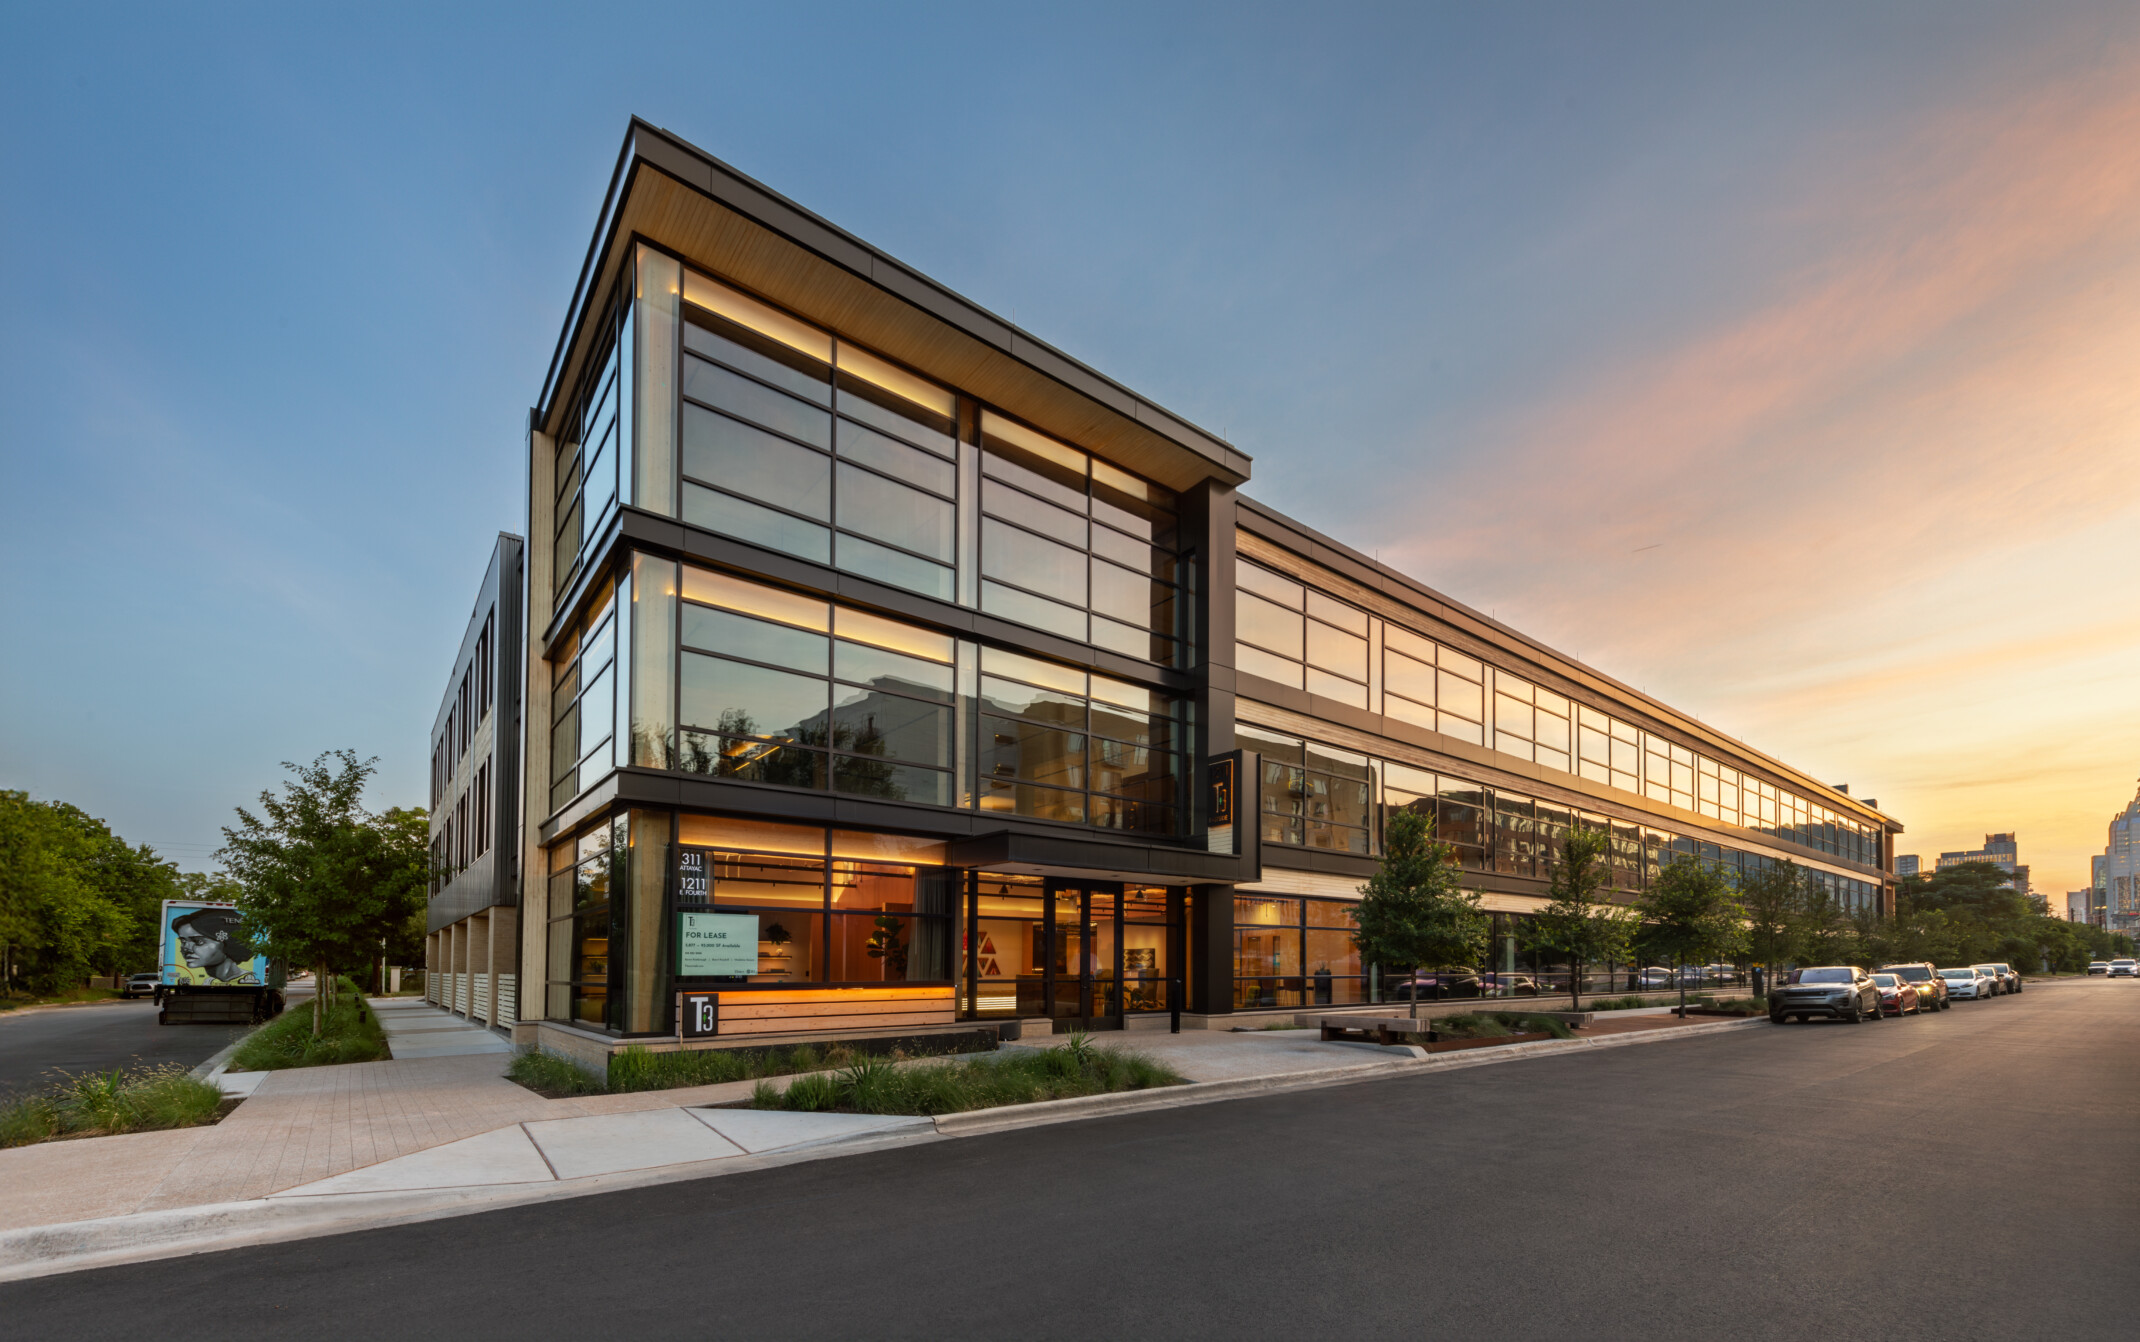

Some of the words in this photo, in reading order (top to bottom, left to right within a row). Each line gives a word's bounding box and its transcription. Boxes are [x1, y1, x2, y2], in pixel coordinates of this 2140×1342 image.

[1212, 782, 1227, 813] T3
[682, 853, 701, 865] 311
[682, 877, 706, 890] 1211
[685, 931, 701, 939] FOR
[690, 996, 713, 1032] T3
